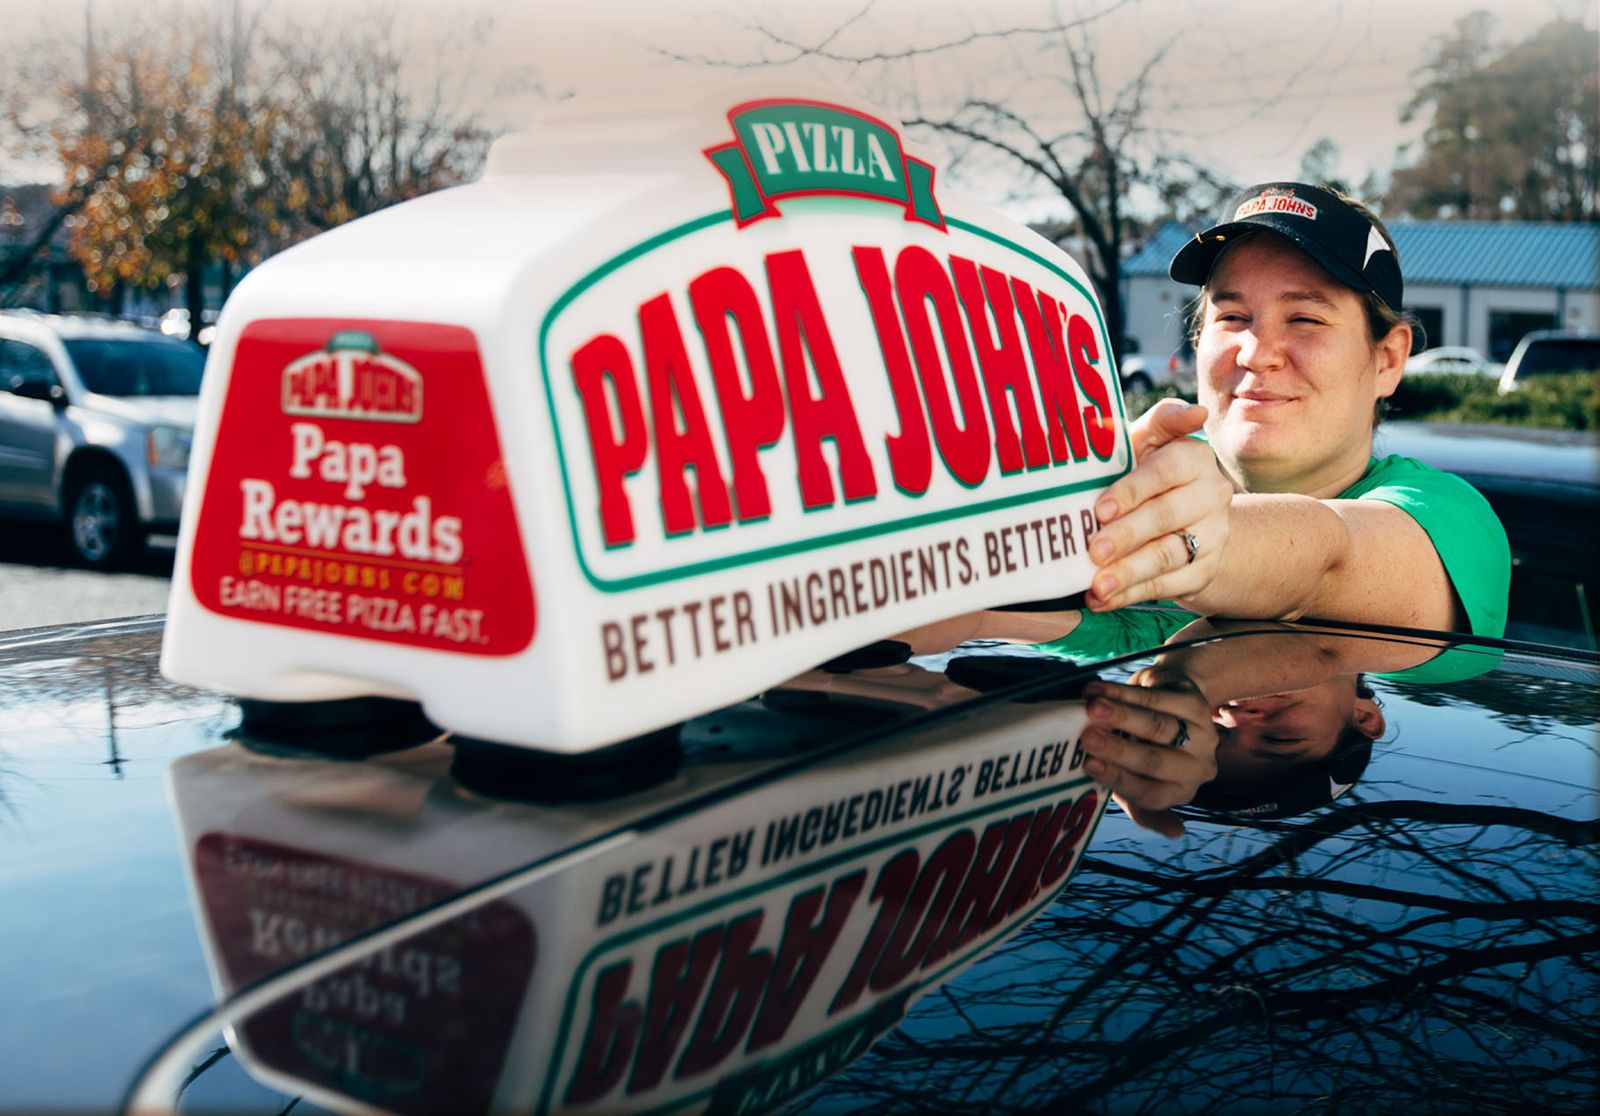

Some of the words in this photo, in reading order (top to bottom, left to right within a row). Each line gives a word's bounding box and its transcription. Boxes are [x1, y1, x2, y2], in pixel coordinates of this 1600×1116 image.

[751, 121, 897, 183] PIZZA
[570, 248, 878, 551] PAPA
[851, 244, 1116, 497] JOHN'S
[290, 423, 407, 500] Papa
[239, 479, 463, 565] Rewards
[219, 575, 281, 612] EARN
[283, 584, 343, 624] FREE
[346, 593, 417, 634] PIZZA
[601, 589, 758, 683] BETTER
[767, 537, 980, 638] INGREDIENTS.
[984, 513, 1078, 578] BETTER
